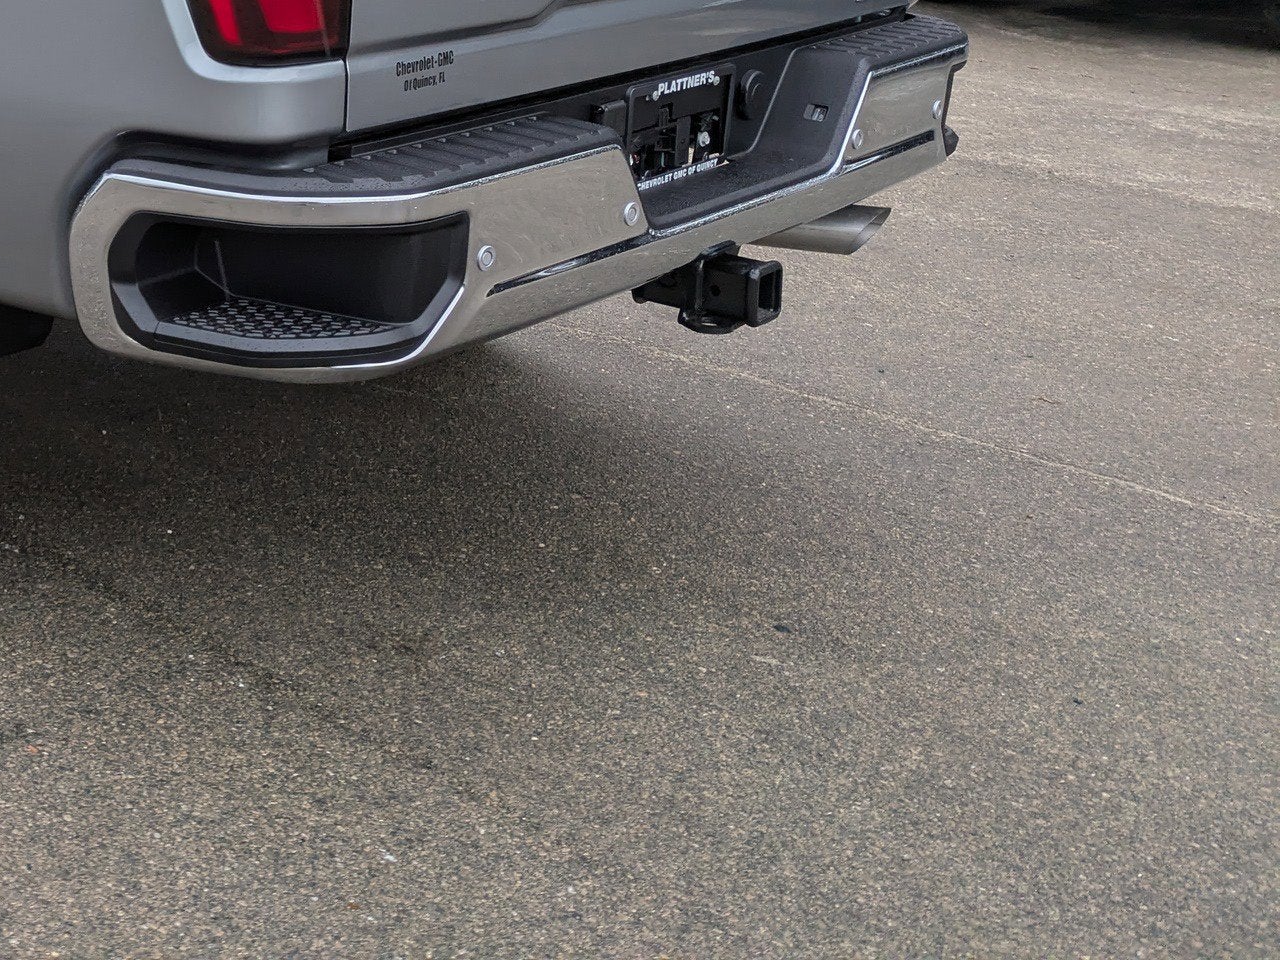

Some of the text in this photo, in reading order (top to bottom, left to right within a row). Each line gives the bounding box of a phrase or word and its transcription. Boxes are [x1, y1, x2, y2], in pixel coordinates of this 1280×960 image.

[658, 70, 715, 96] PLATTNER'S
[673, 167, 688, 181] GMC
[688, 162, 697, 176] OF
[696, 158, 719, 172] QUINCY
